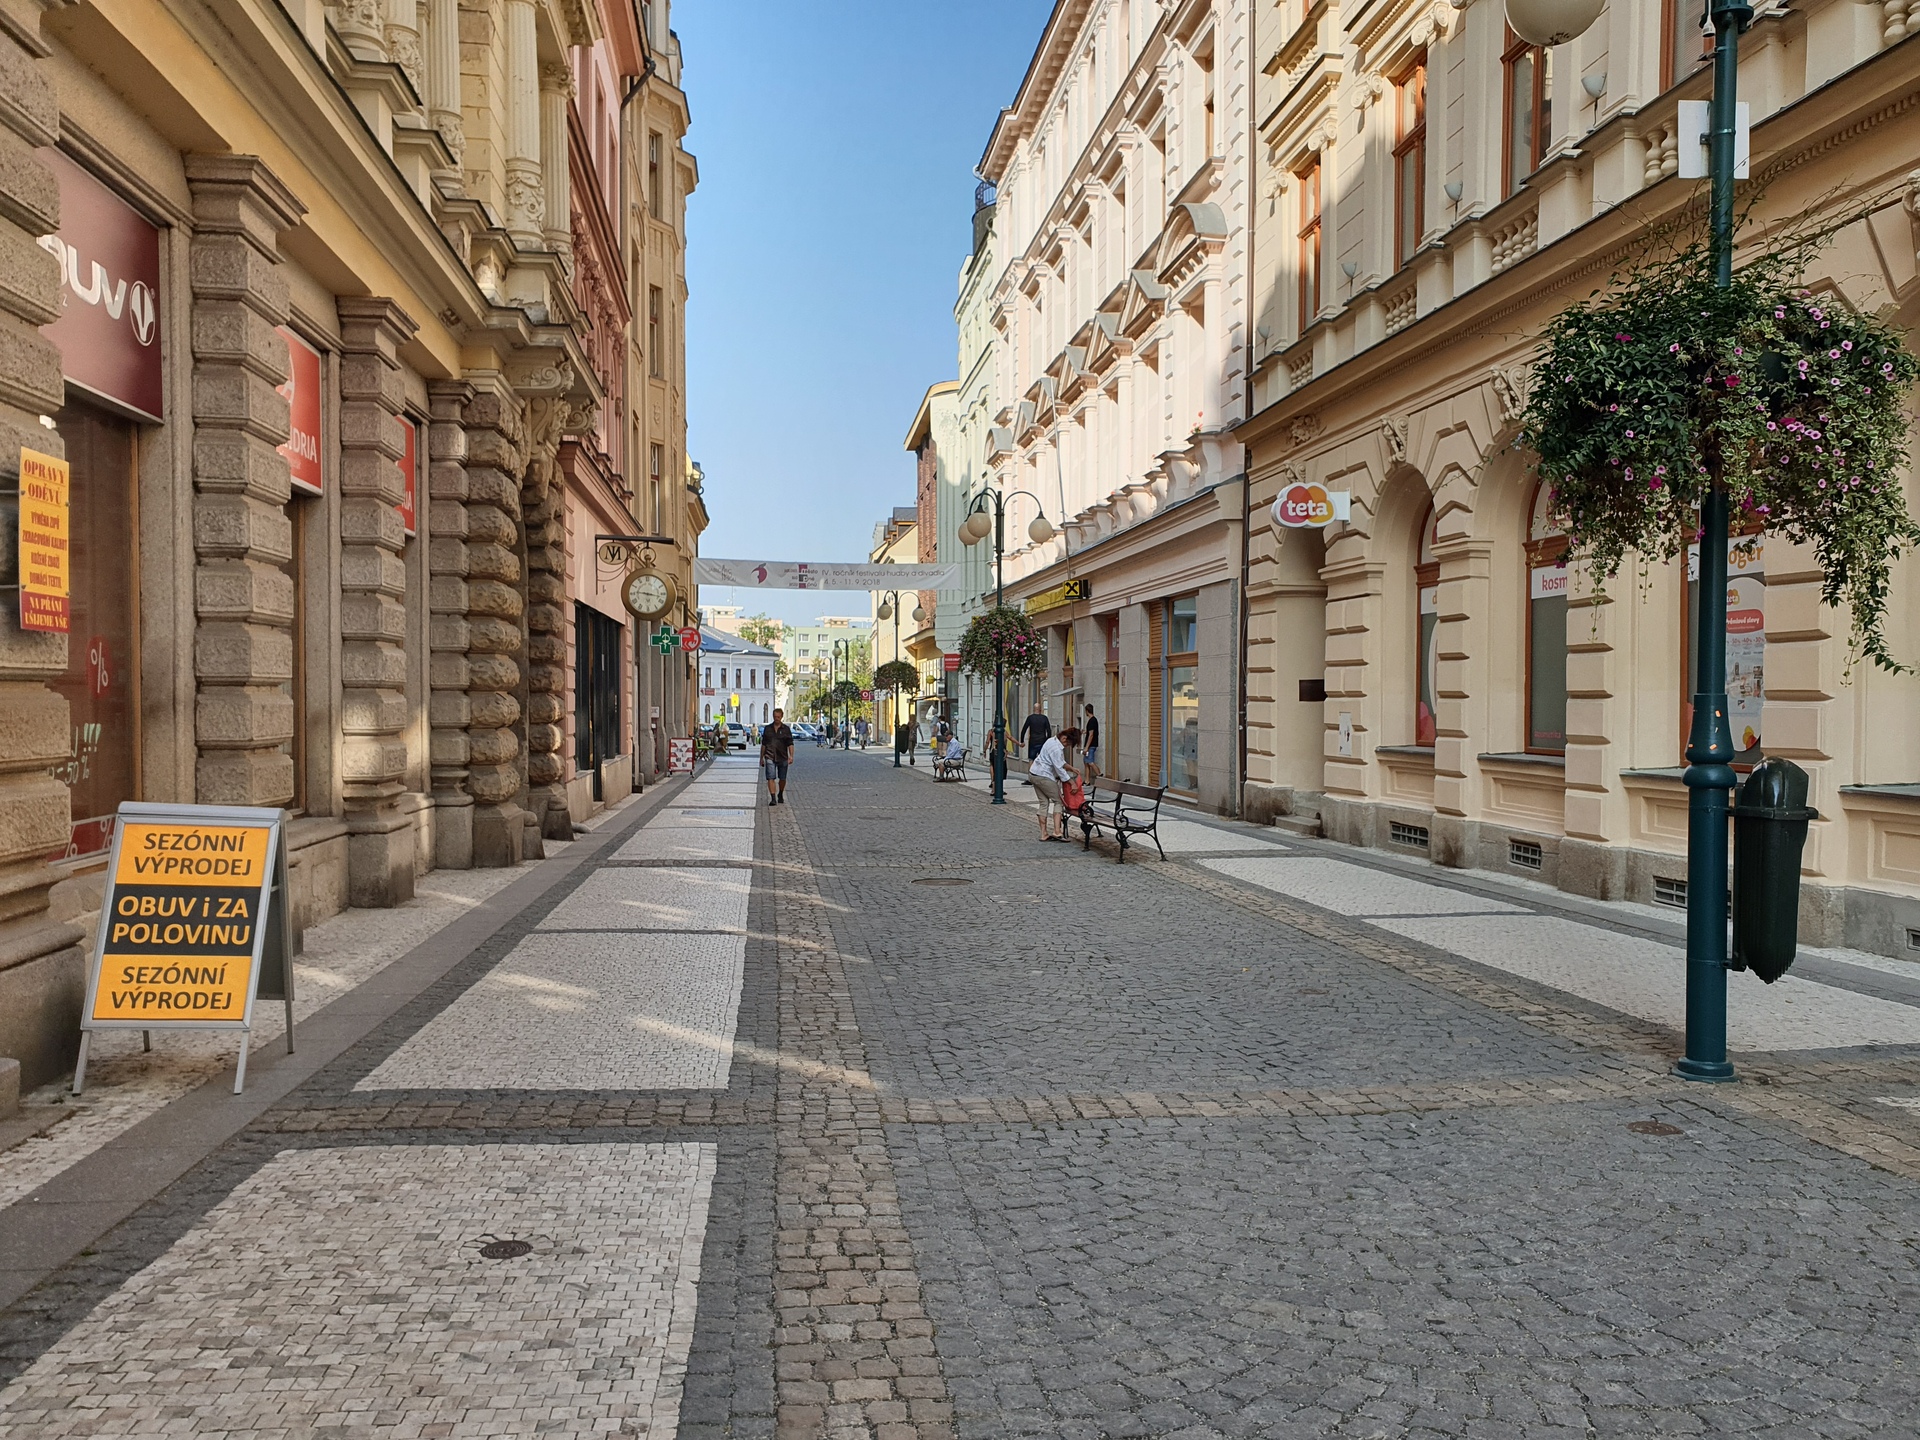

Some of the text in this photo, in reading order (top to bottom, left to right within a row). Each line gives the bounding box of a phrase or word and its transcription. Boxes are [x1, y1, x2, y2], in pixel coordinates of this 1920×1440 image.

[24, 459, 65, 484] OPRAVY
[28, 482, 61, 505] ODĚVŮ
[1287, 500, 1328, 516] teta
[887, 570, 909, 578] hudby
[918, 569, 945, 577] divadla
[29, 595, 62, 613] NA PŘÁNÍ
[25, 610, 68, 629] UŠIJEME VŠE
[143, 830, 248, 852] SEZÓNNÍ
[134, 852, 252, 876] VÝPRODEJ
[117, 895, 249, 918] OBUV i ZA
[112, 923, 250, 945] POLOVINU
[121, 962, 229, 985] SEZÓNNÍ
[111, 986, 232, 1010] VÝPRODEJ
